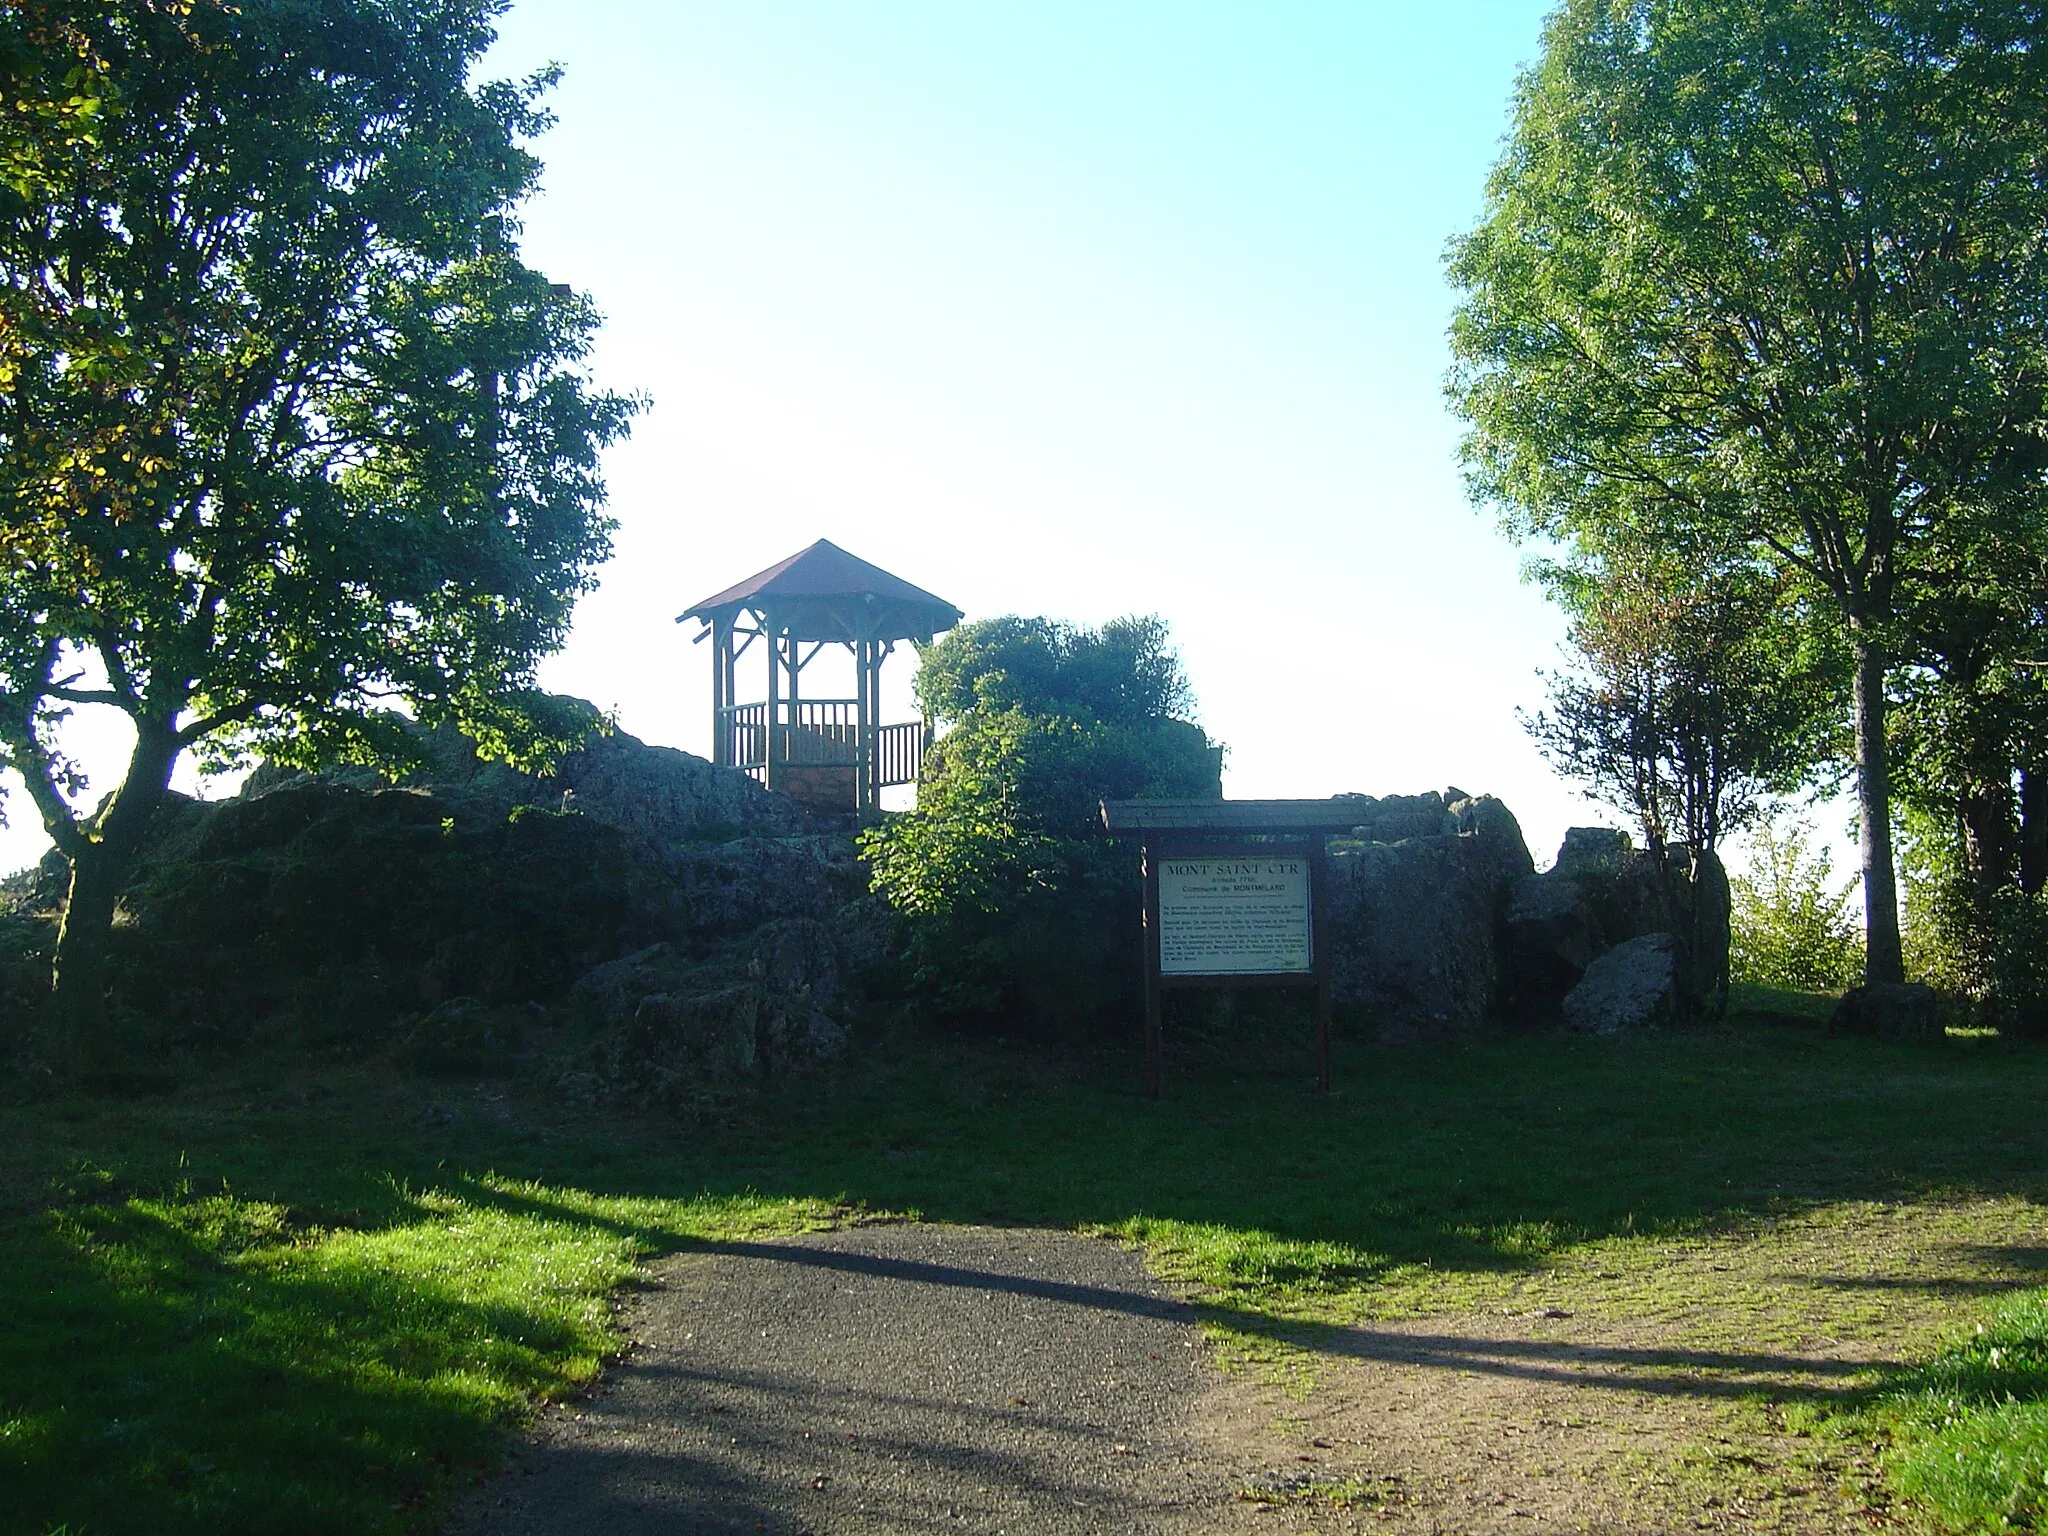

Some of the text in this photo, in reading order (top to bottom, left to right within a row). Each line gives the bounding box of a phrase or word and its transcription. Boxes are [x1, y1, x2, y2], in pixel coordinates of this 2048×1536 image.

[1167, 863, 1299, 875] MONT SAINT CYR
